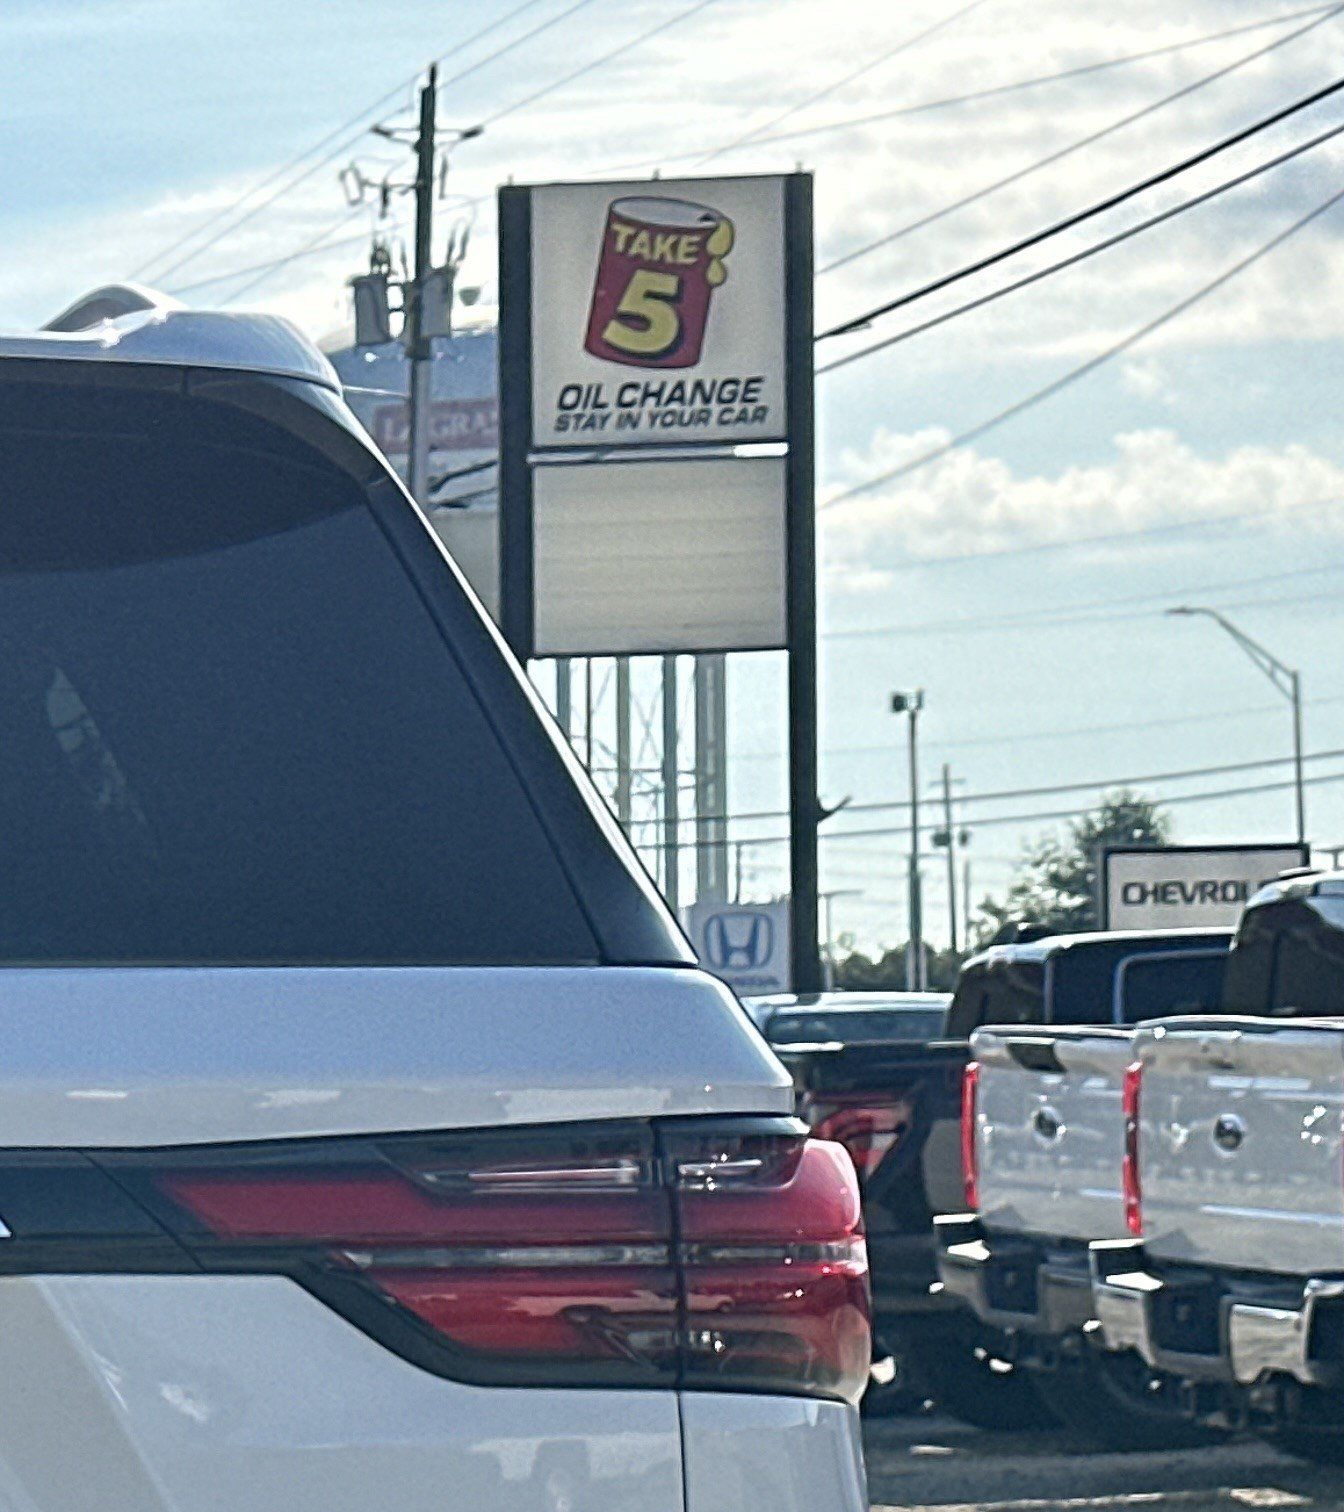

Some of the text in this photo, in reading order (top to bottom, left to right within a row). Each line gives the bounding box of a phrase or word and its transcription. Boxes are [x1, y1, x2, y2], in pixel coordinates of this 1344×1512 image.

[611, 222, 702, 266] TAKE
[602, 268, 682, 354] 5
[557, 375, 765, 411] OIL CHANGE
[553, 405, 769, 432] STAY IN YOUR CAR
[1122, 880, 1267, 905] CHEVROL
